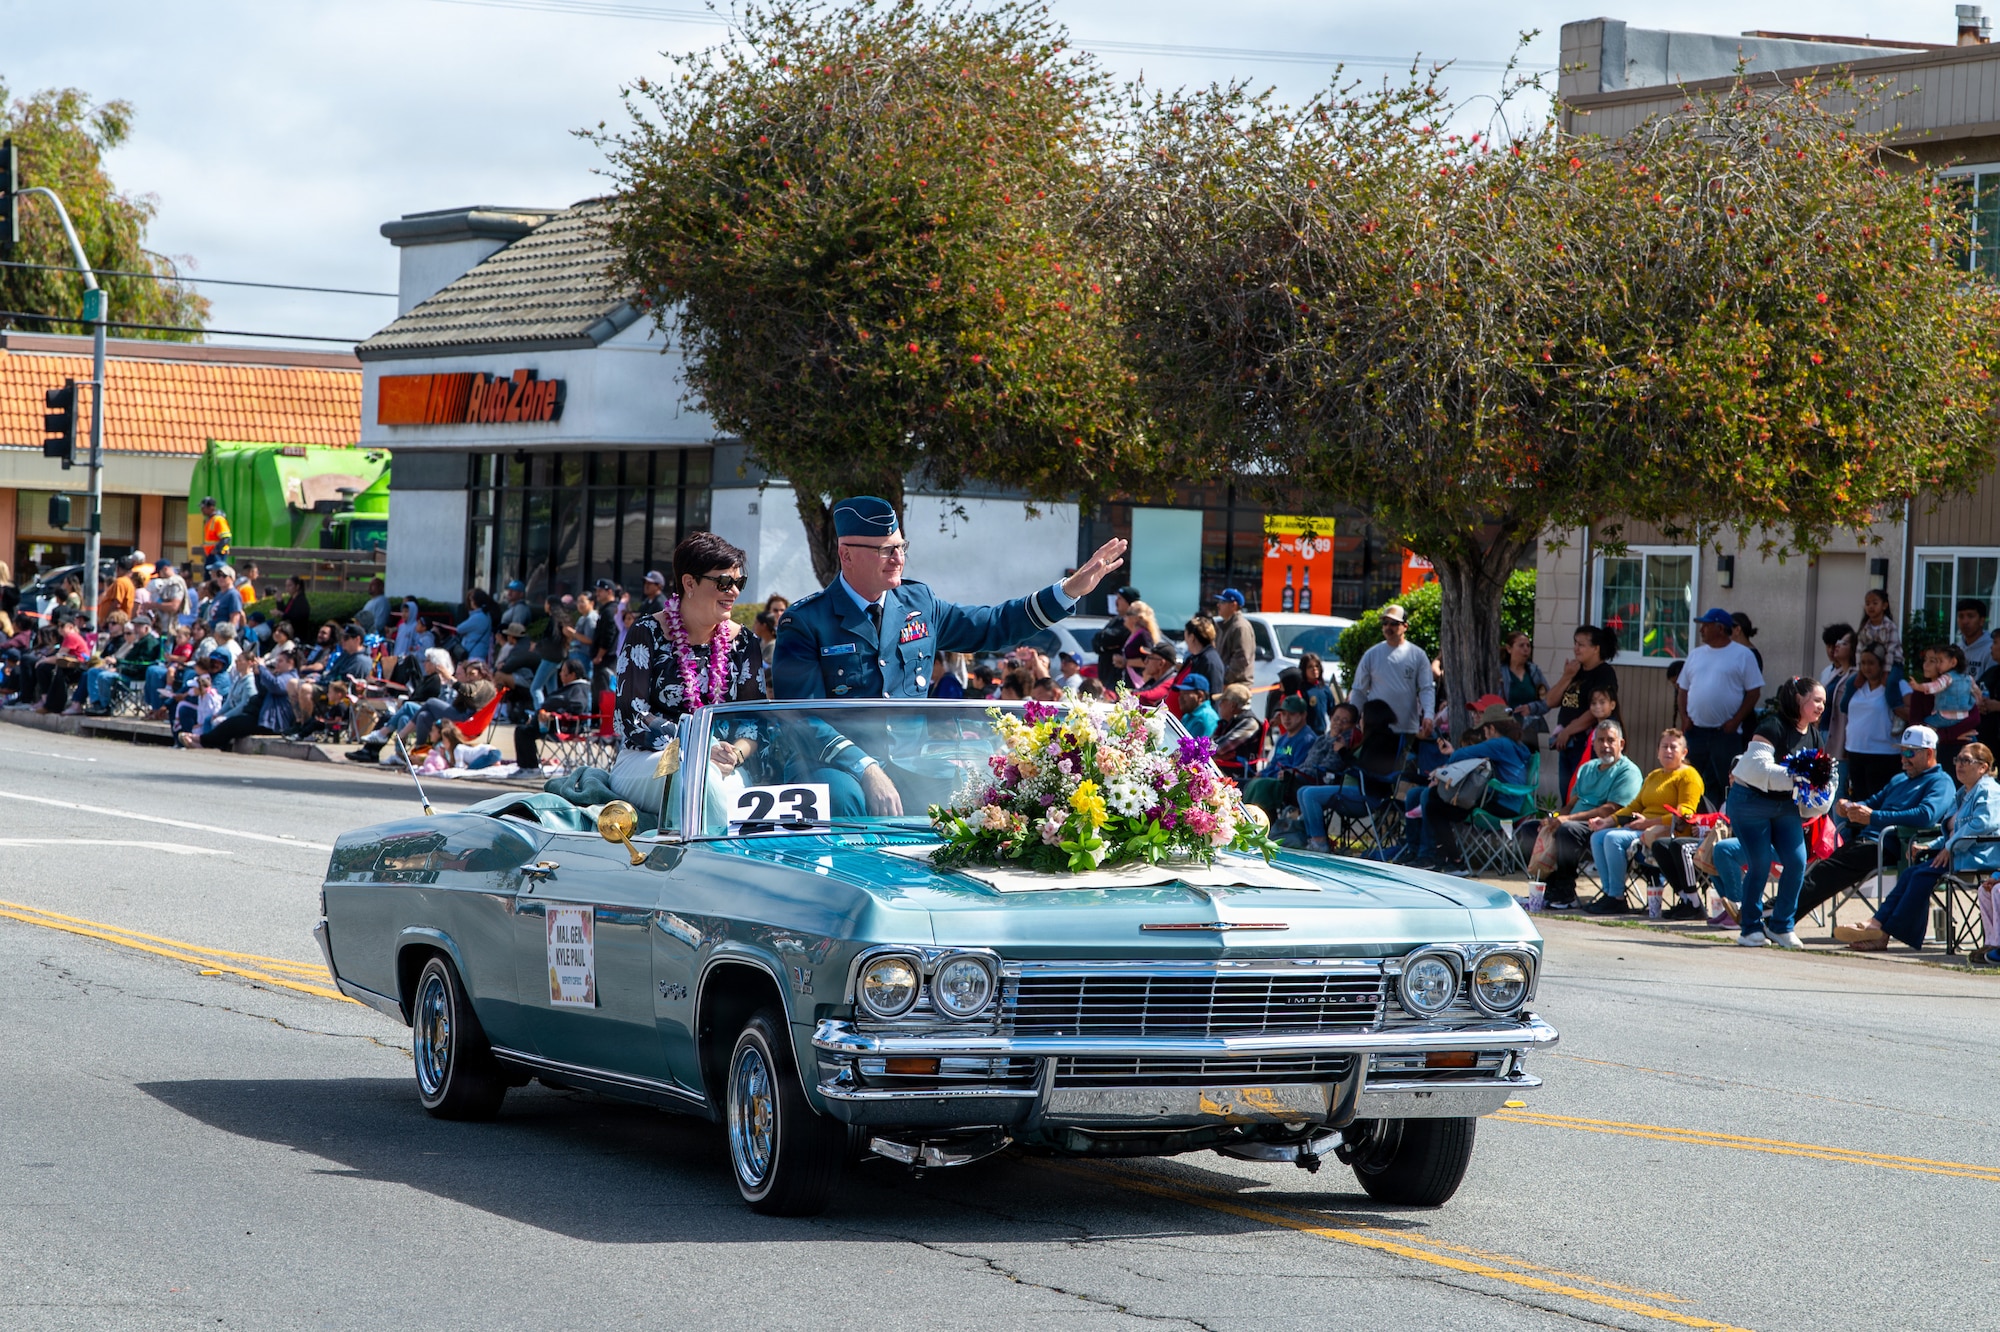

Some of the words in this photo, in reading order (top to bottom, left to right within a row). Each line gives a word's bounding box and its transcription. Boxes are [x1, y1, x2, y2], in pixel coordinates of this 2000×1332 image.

[465, 369, 558, 423] AutoZone
[1267, 537, 1280, 558] 2
[738, 788, 818, 835] 23
[556, 925, 570, 943] MAJ.
[570, 925, 584, 944] GEN.
[555, 948, 570, 966] KYLE
[570, 948, 586, 967] PAUL
